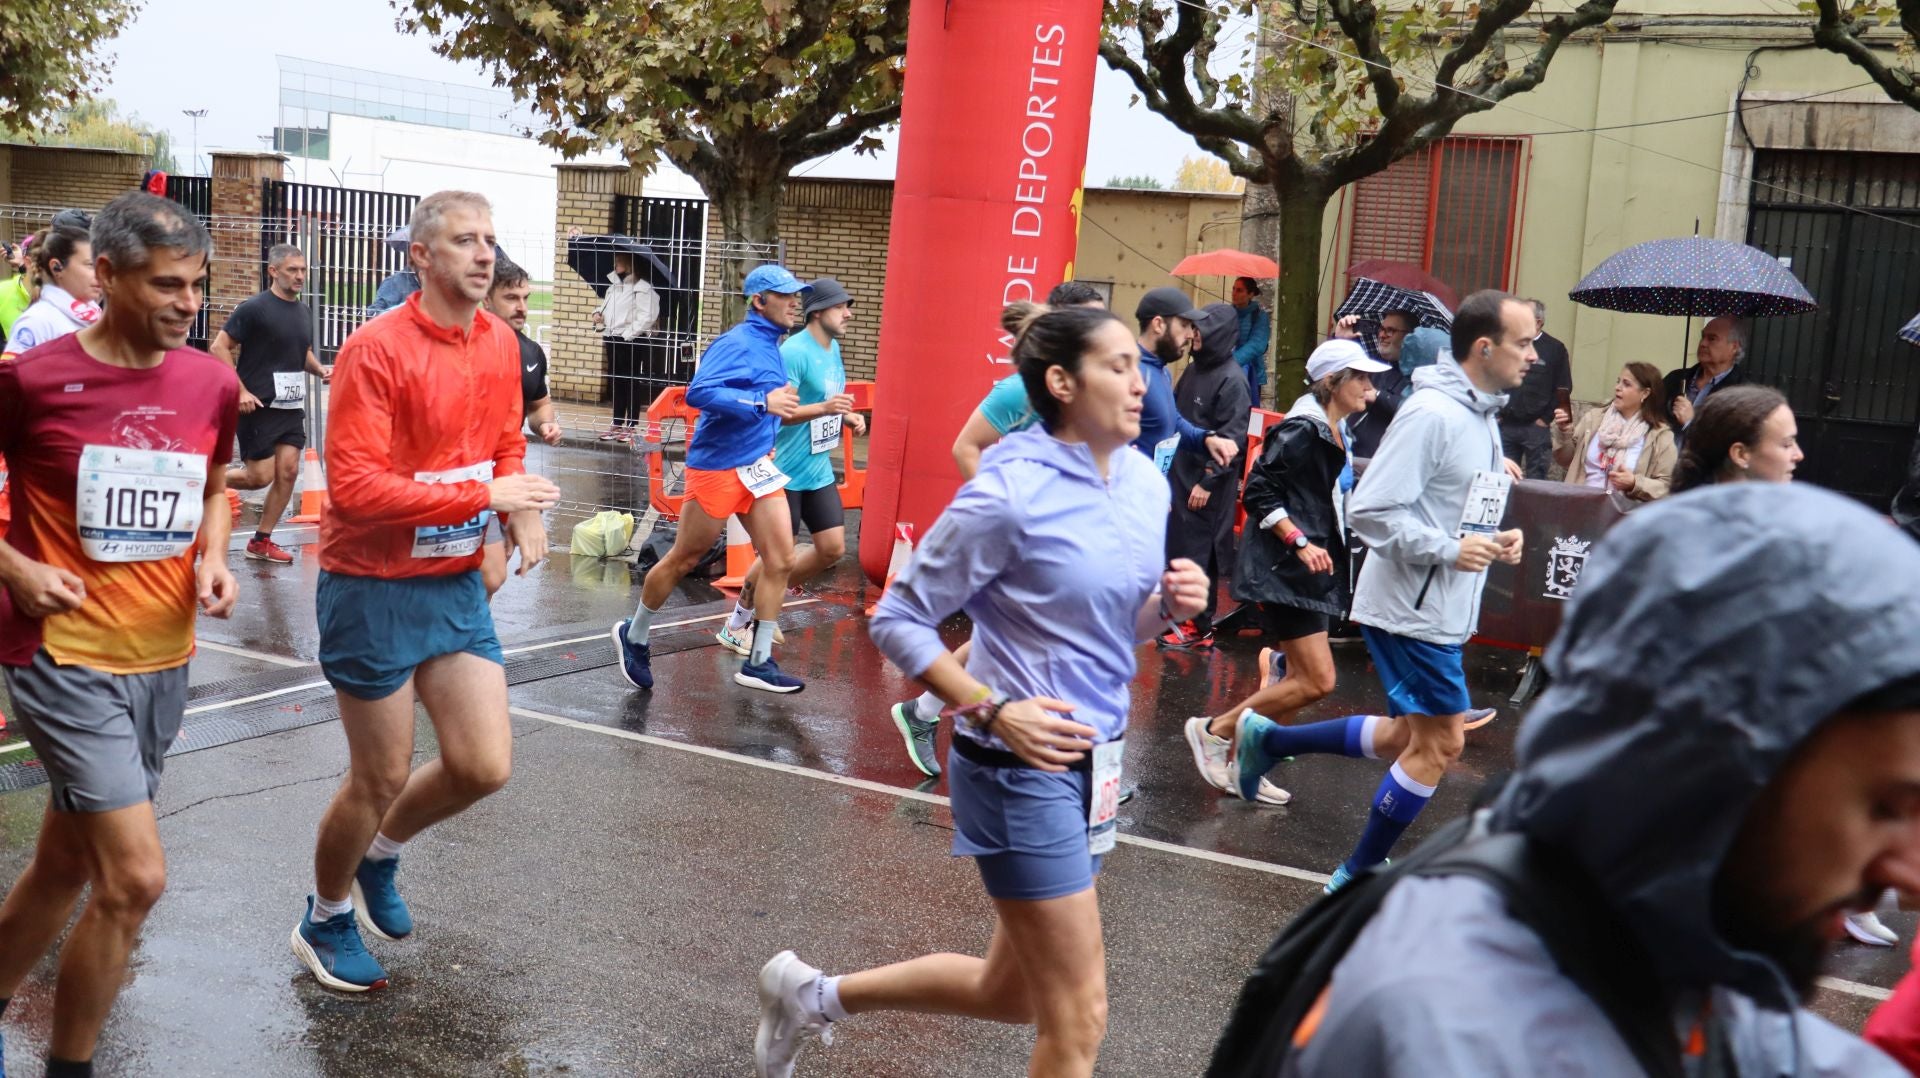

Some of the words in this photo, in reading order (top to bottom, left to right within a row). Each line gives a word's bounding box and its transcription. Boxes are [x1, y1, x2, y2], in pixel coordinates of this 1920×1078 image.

[1012, 23, 1066, 237] DEPORTES
[284, 385, 301, 401] 750
[822, 417, 839, 438] 862
[746, 463, 771, 483] 745
[105, 487, 181, 529] 1067
[125, 543, 175, 553] HYUNDAI
